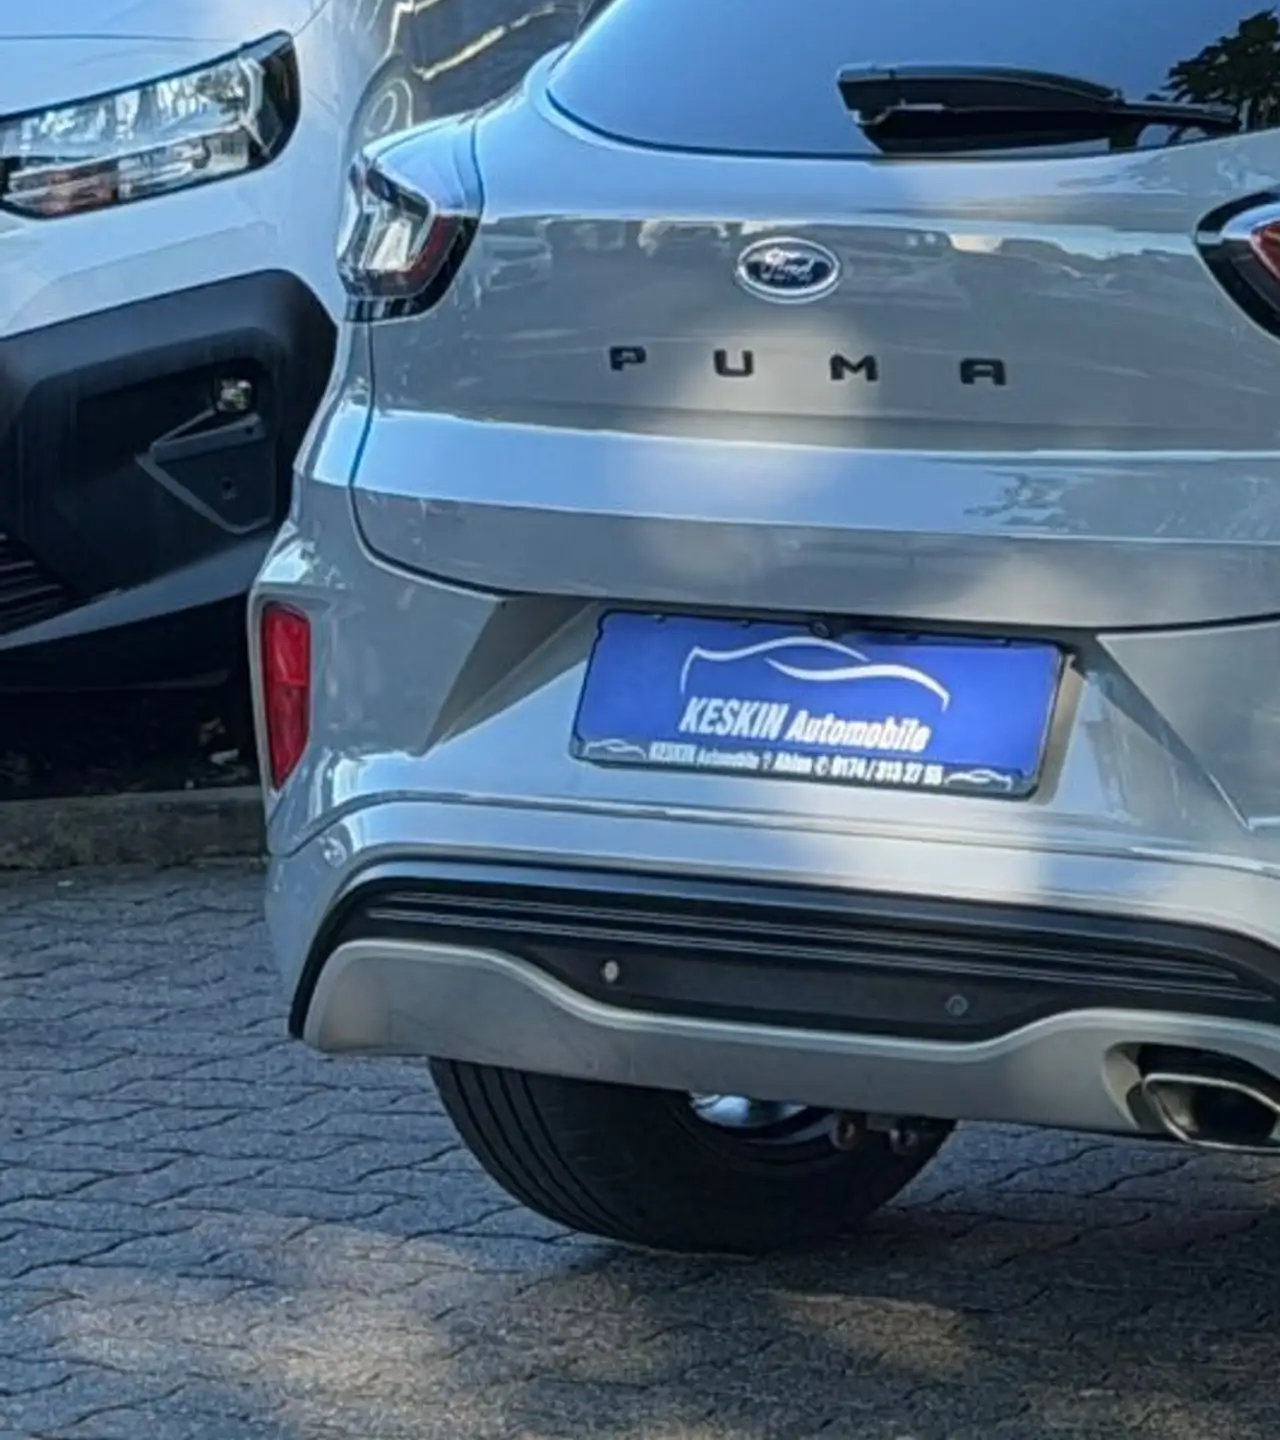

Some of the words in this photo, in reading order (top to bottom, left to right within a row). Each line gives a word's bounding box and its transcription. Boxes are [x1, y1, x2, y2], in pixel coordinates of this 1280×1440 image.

[609, 346, 1007, 386] PUMA
[680, 695, 788, 740] KESKIN
[786, 710, 932, 753] Automobile
